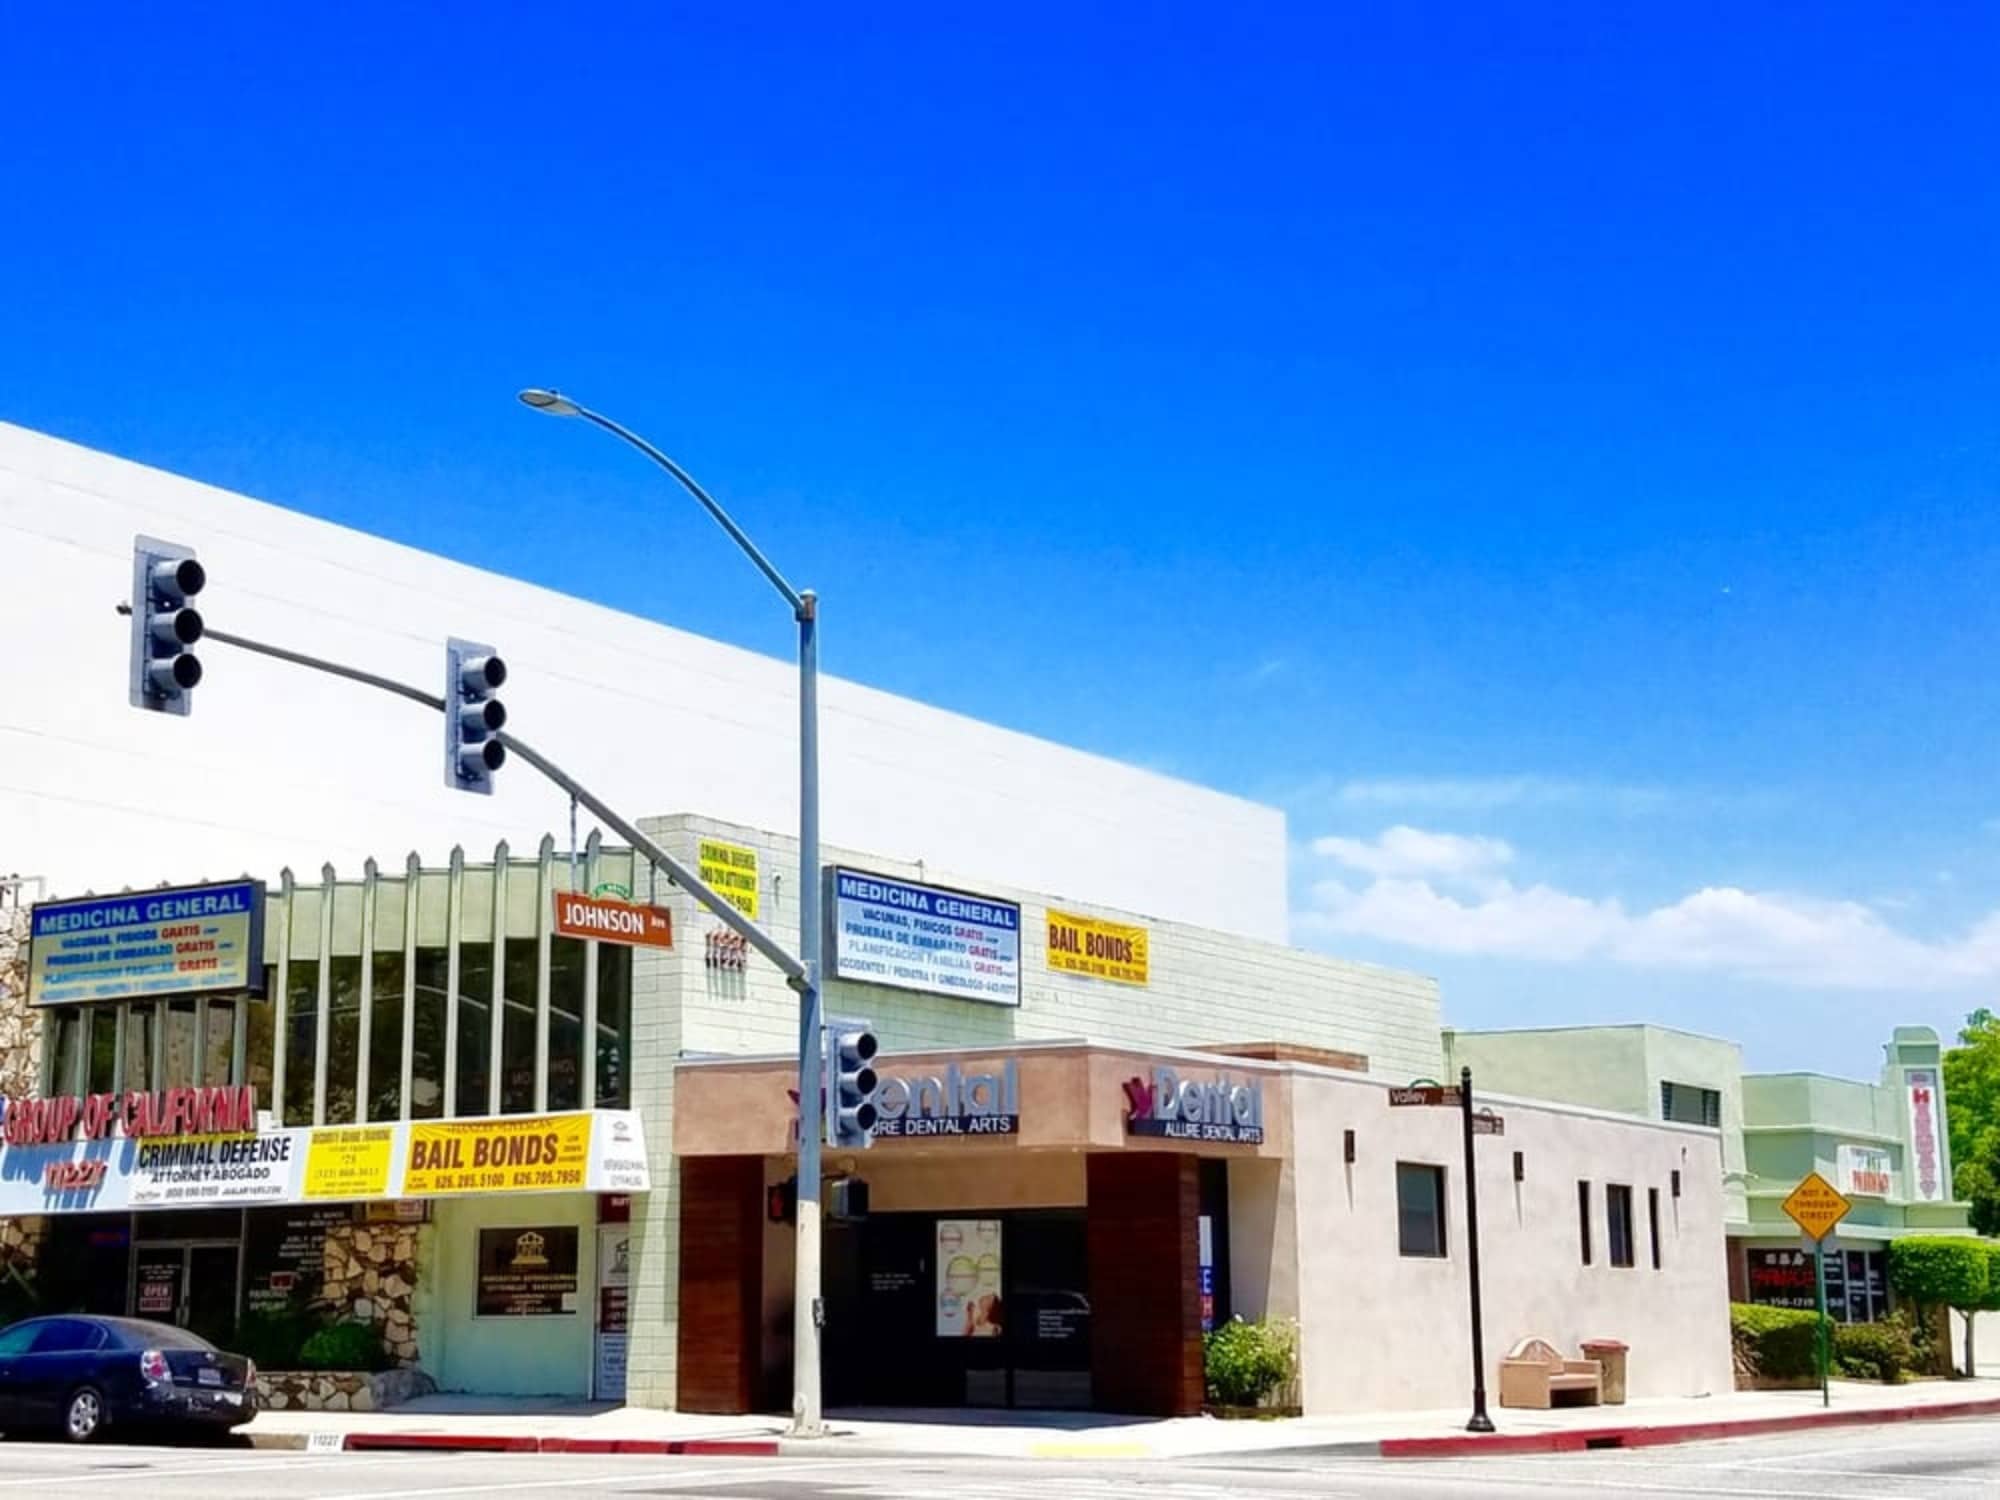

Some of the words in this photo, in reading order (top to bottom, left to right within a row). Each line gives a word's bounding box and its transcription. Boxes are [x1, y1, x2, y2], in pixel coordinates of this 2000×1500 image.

[841, 878, 928, 911] MEDICINA
[936, 899, 1015, 926] GENERAL
[40, 905, 139, 933] MEDICINA
[147, 893, 245, 919] GENERAL
[564, 902, 645, 935] JOHNSON
[161, 925, 201, 940] GRATIS
[896, 932, 910, 945] DE
[176, 940, 215, 955] GRATIS
[1049, 924, 1082, 954] BAIL
[1085, 931, 1134, 964] BONDS
[178, 957, 218, 972] GRATIS
[872, 1057, 1018, 1119] ental
[1154, 1065, 1264, 1128] Dental
[3, 1096, 79, 1145] GROUP
[83, 1091, 115, 1139] OF
[122, 1085, 256, 1139] CALIFORNIA
[905, 1119, 963, 1135] DENTAL
[969, 1117, 1011, 1132] ARTS
[1165, 1122, 1200, 1137] ALLURE
[1202, 1125, 1236, 1140] DENTAL
[1238, 1127, 1262, 1142] ARTS
[139, 1140, 215, 1168] CRIMINAL
[219, 1137, 292, 1164] DEFENSE
[411, 1139, 464, 1170] BAIL
[473, 1133, 559, 1168] BONDS
[152, 1170, 210, 1183] ATTORNEY
[211, 1168, 270, 1181] ABOGADO
[1801, 1189, 1819, 1197] NOT
[1793, 1200, 1838, 1209] THROUGH
[1800, 1211, 1833, 1220] STREET
